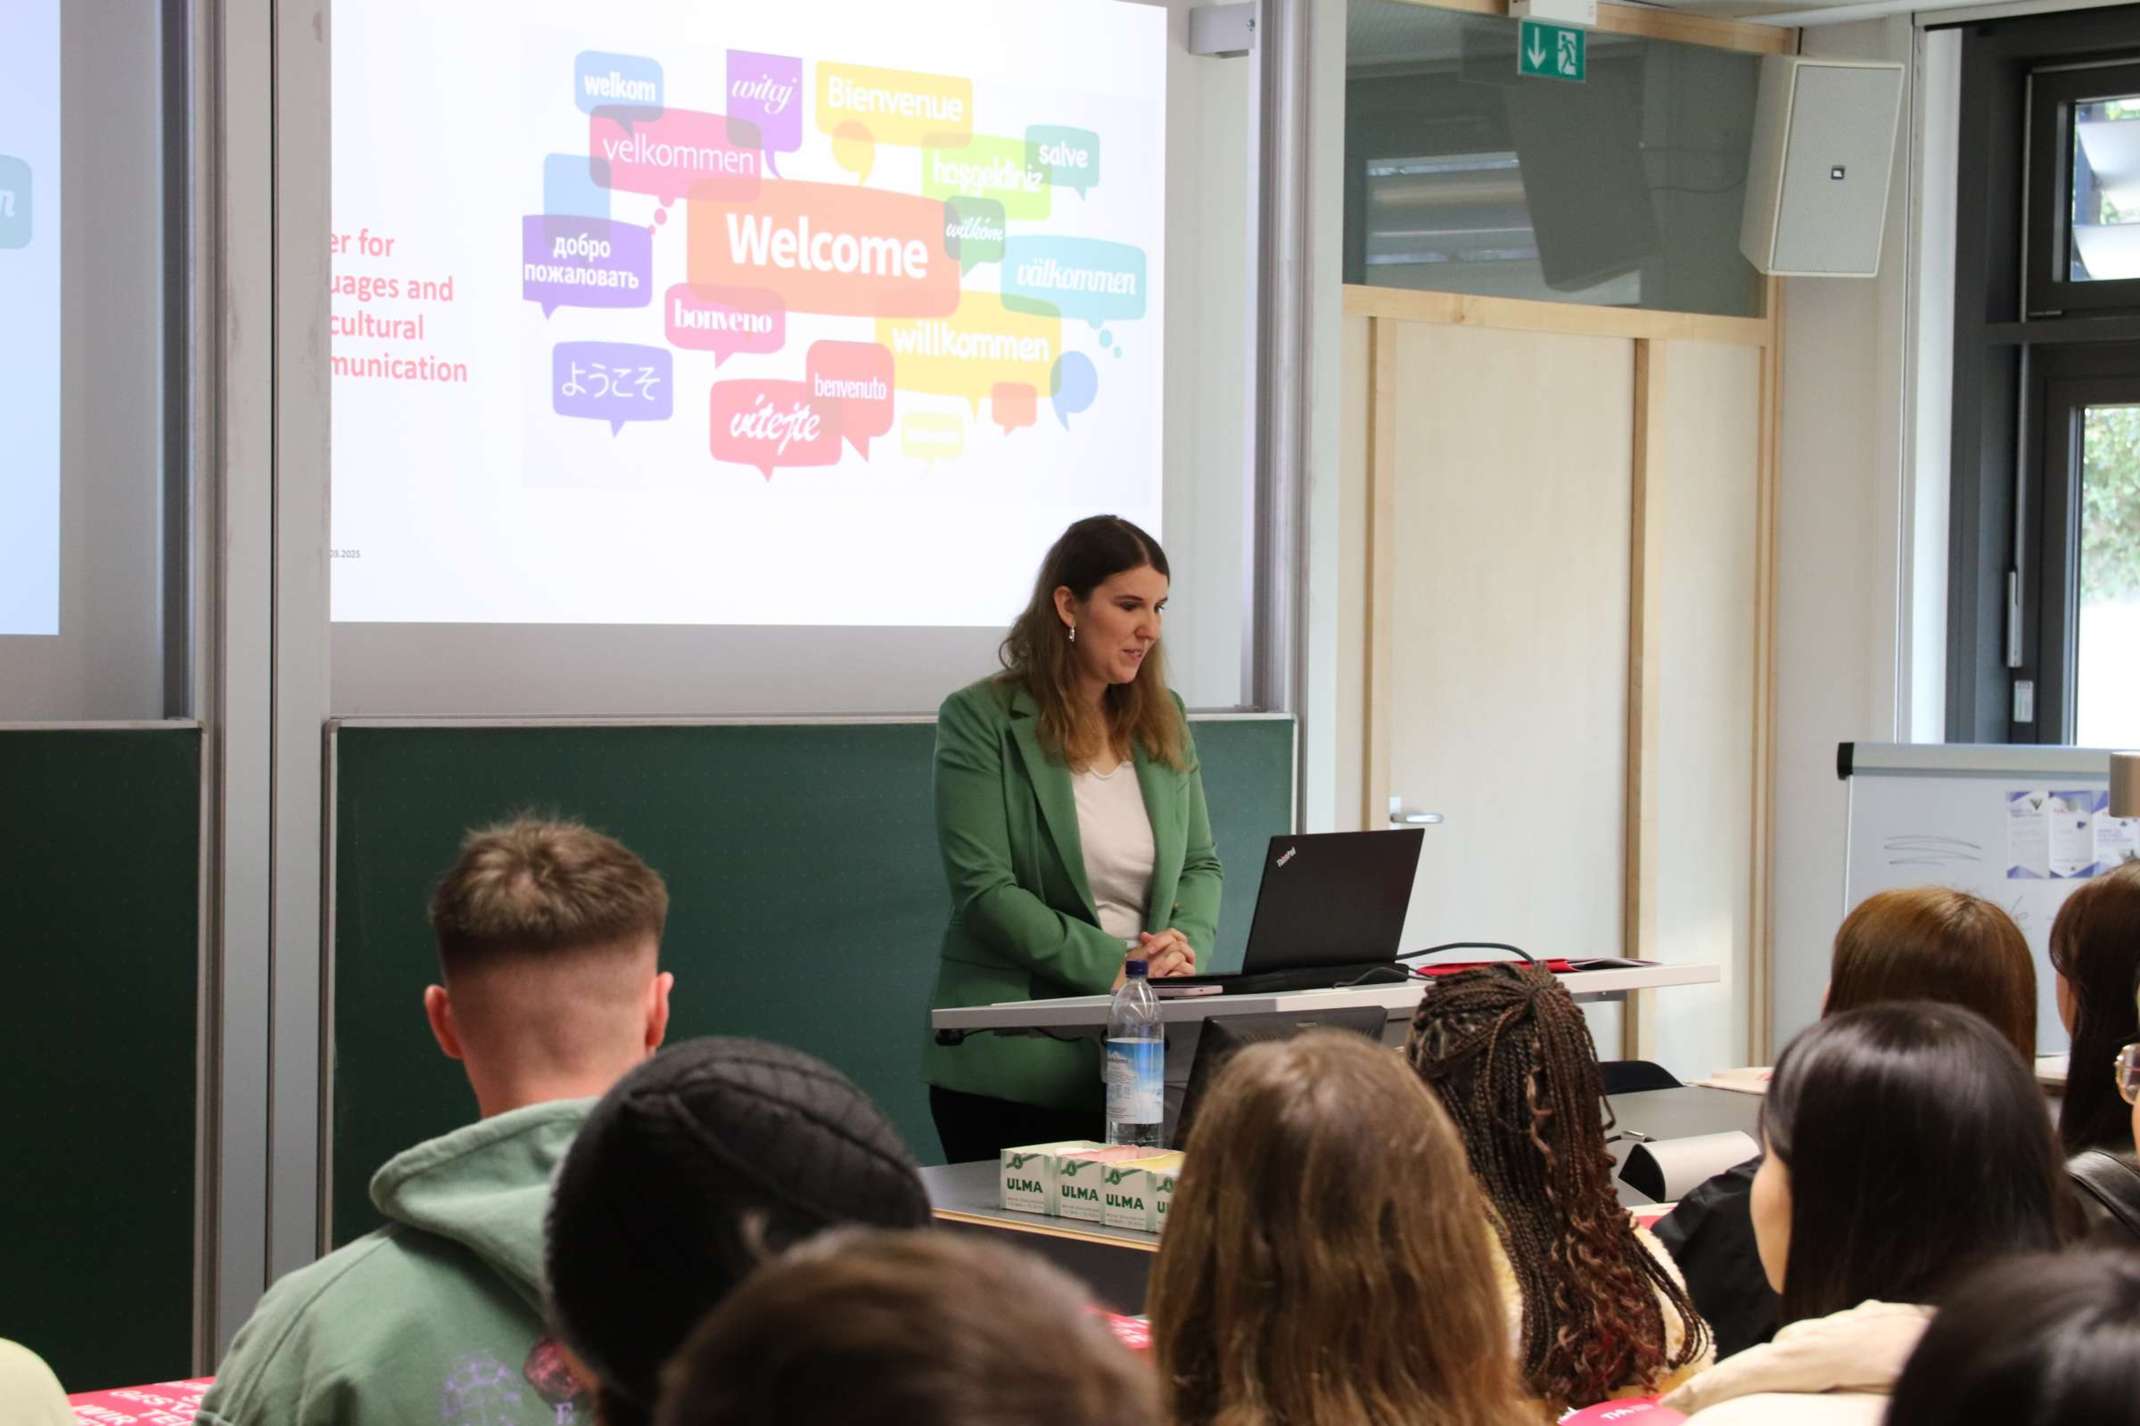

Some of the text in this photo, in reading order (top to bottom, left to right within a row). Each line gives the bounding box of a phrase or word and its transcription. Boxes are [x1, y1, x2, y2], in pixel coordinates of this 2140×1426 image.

[583, 71, 656, 102] welkom
[827, 75, 965, 121] Bienvenue
[602, 134, 755, 174] velkommen
[1038, 143, 1088, 168] salve
[358, 228, 395, 257] for
[553, 232, 611, 262] добро
[726, 212, 929, 280] Welcome
[407, 275, 454, 301] and
[524, 263, 640, 289] пожаловать
[330, 310, 424, 340] cultural
[892, 320, 1050, 363] willkommen
[561, 360, 661, 401] ようこそ
[814, 373, 887, 401] benvenuto
[1007, 1177, 1042, 1194] ULMA
[1061, 1184, 1099, 1201] ULMA
[1106, 1193, 1144, 1210] ULMA
